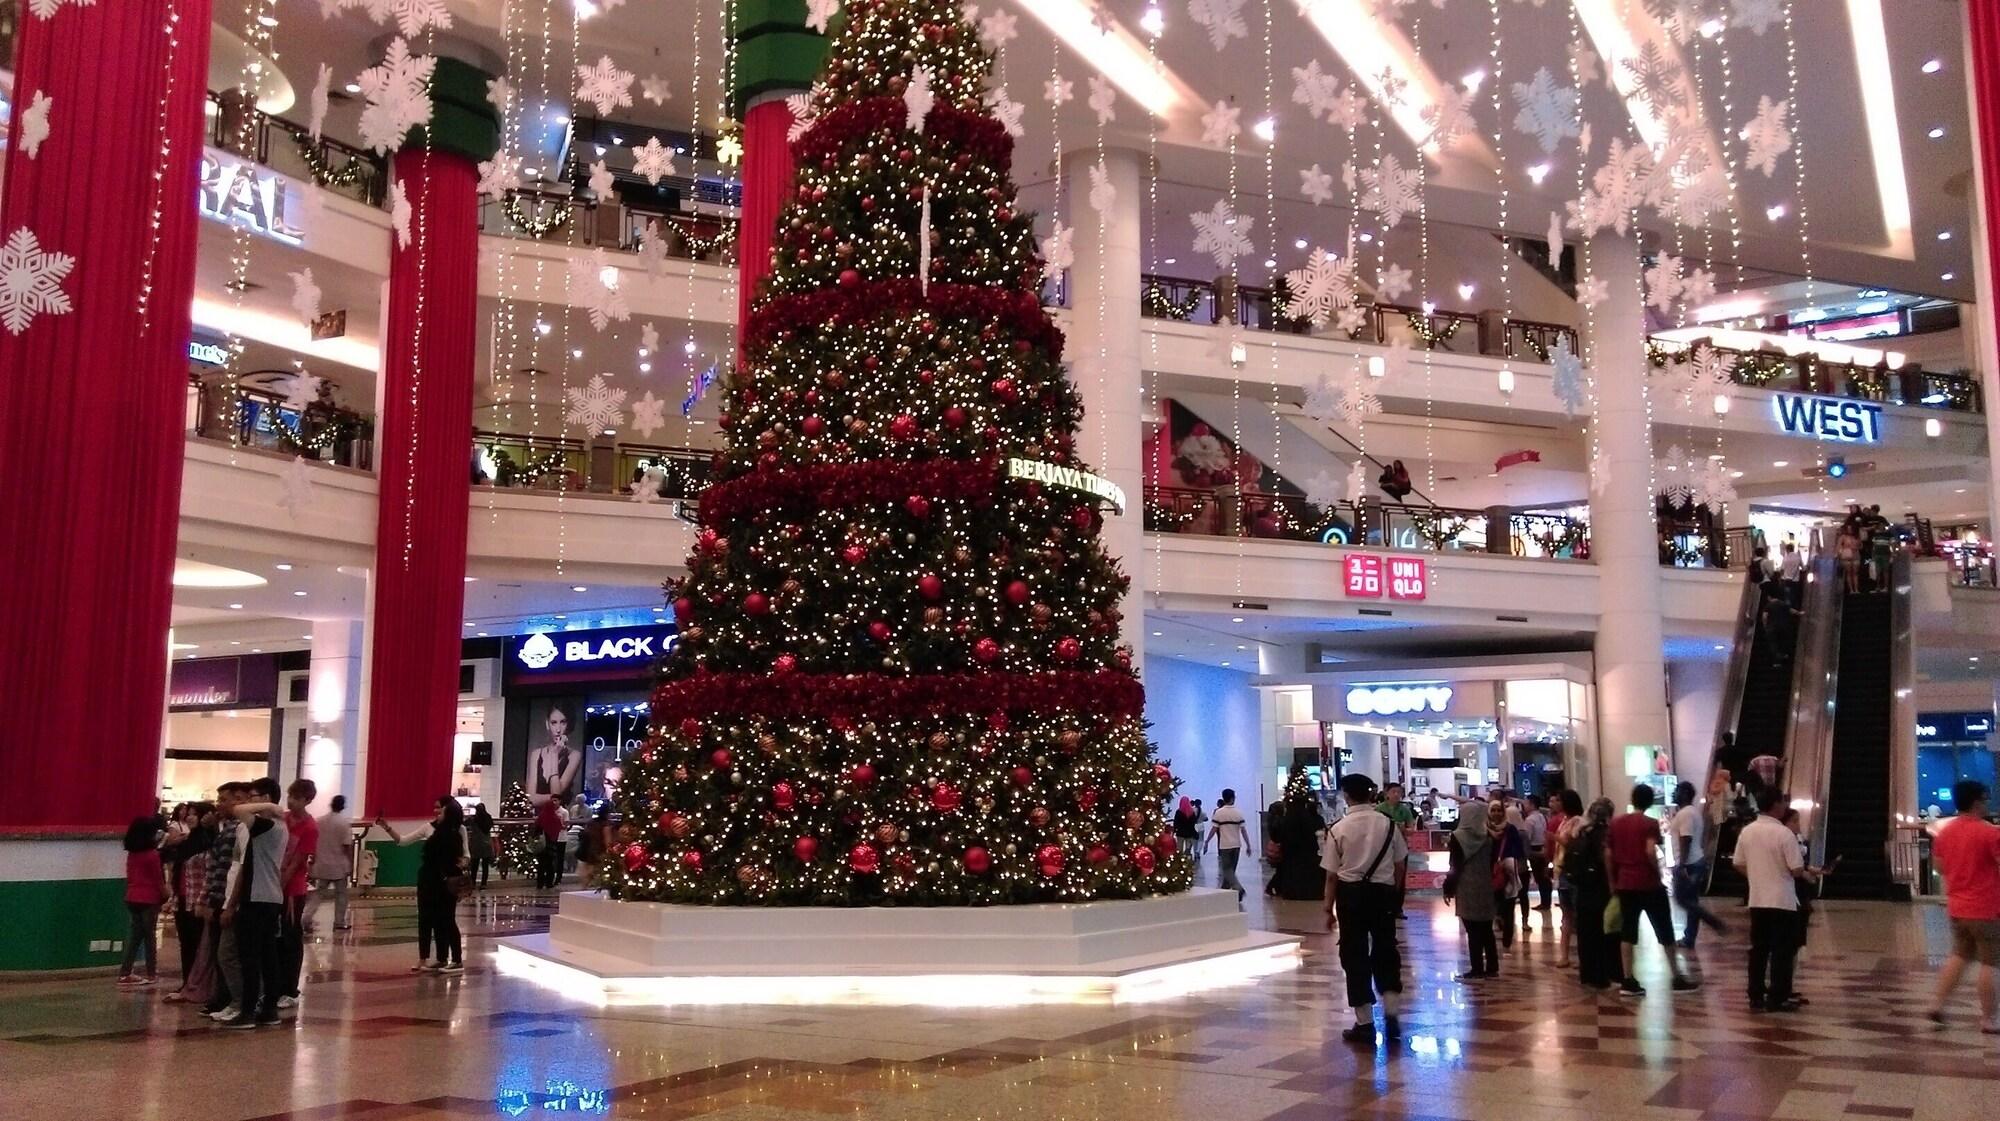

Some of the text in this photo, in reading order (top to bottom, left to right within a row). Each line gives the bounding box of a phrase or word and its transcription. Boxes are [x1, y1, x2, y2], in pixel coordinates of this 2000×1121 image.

[1774, 394, 1882, 441] WEST
[1009, 457, 1084, 490] BERJAYA
[1392, 562, 1420, 578] UNI
[1393, 578, 1423, 598] QLO
[565, 636, 653, 661] BLACK
